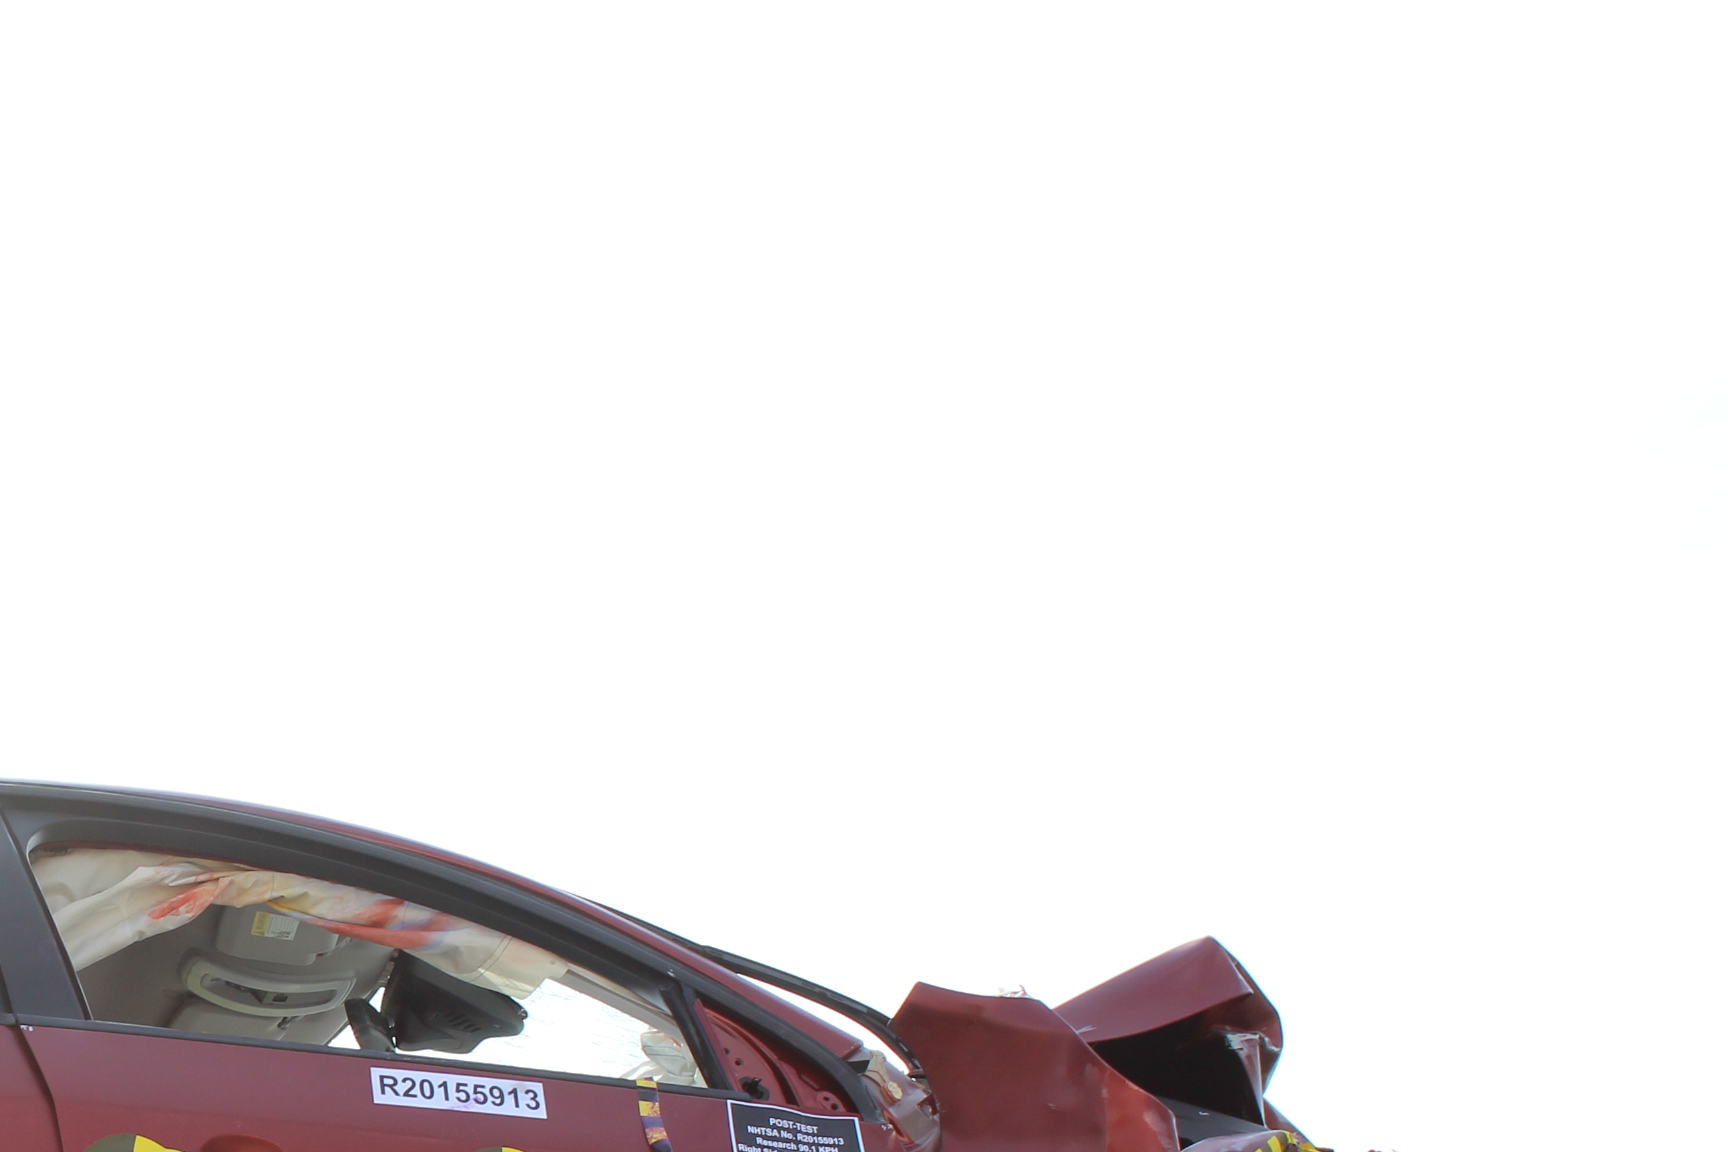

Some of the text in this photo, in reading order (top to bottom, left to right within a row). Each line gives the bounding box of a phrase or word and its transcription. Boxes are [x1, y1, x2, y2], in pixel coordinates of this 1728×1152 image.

[378, 1074, 541, 1111] R20155913
[747, 1125, 780, 1138] NHTSA
[780, 1130, 796, 1141] No.
[769, 1117, 818, 1134] POST-TEST
[756, 1136, 798, 1151] Research
